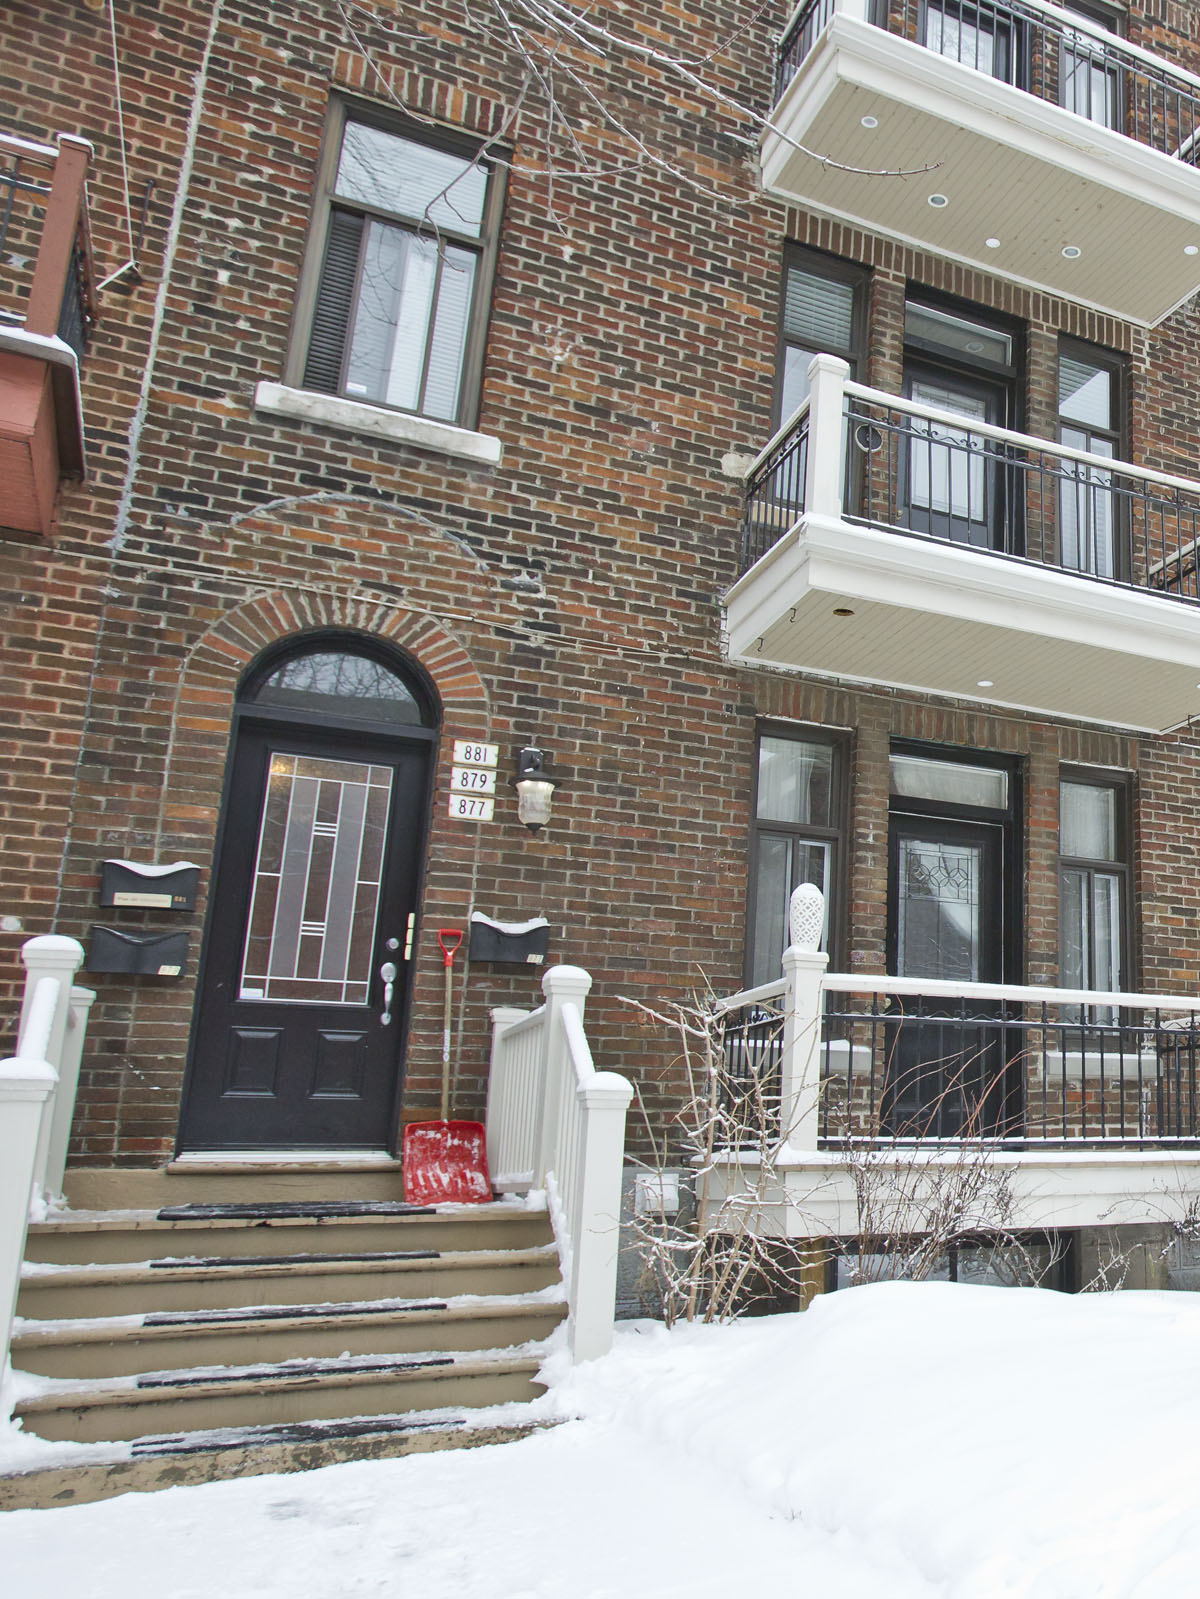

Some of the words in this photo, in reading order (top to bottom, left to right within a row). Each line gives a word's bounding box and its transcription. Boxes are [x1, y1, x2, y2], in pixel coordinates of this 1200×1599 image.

[464, 745, 487, 762] 881
[460, 772, 487, 788] 879
[459, 799, 485, 816] 877
